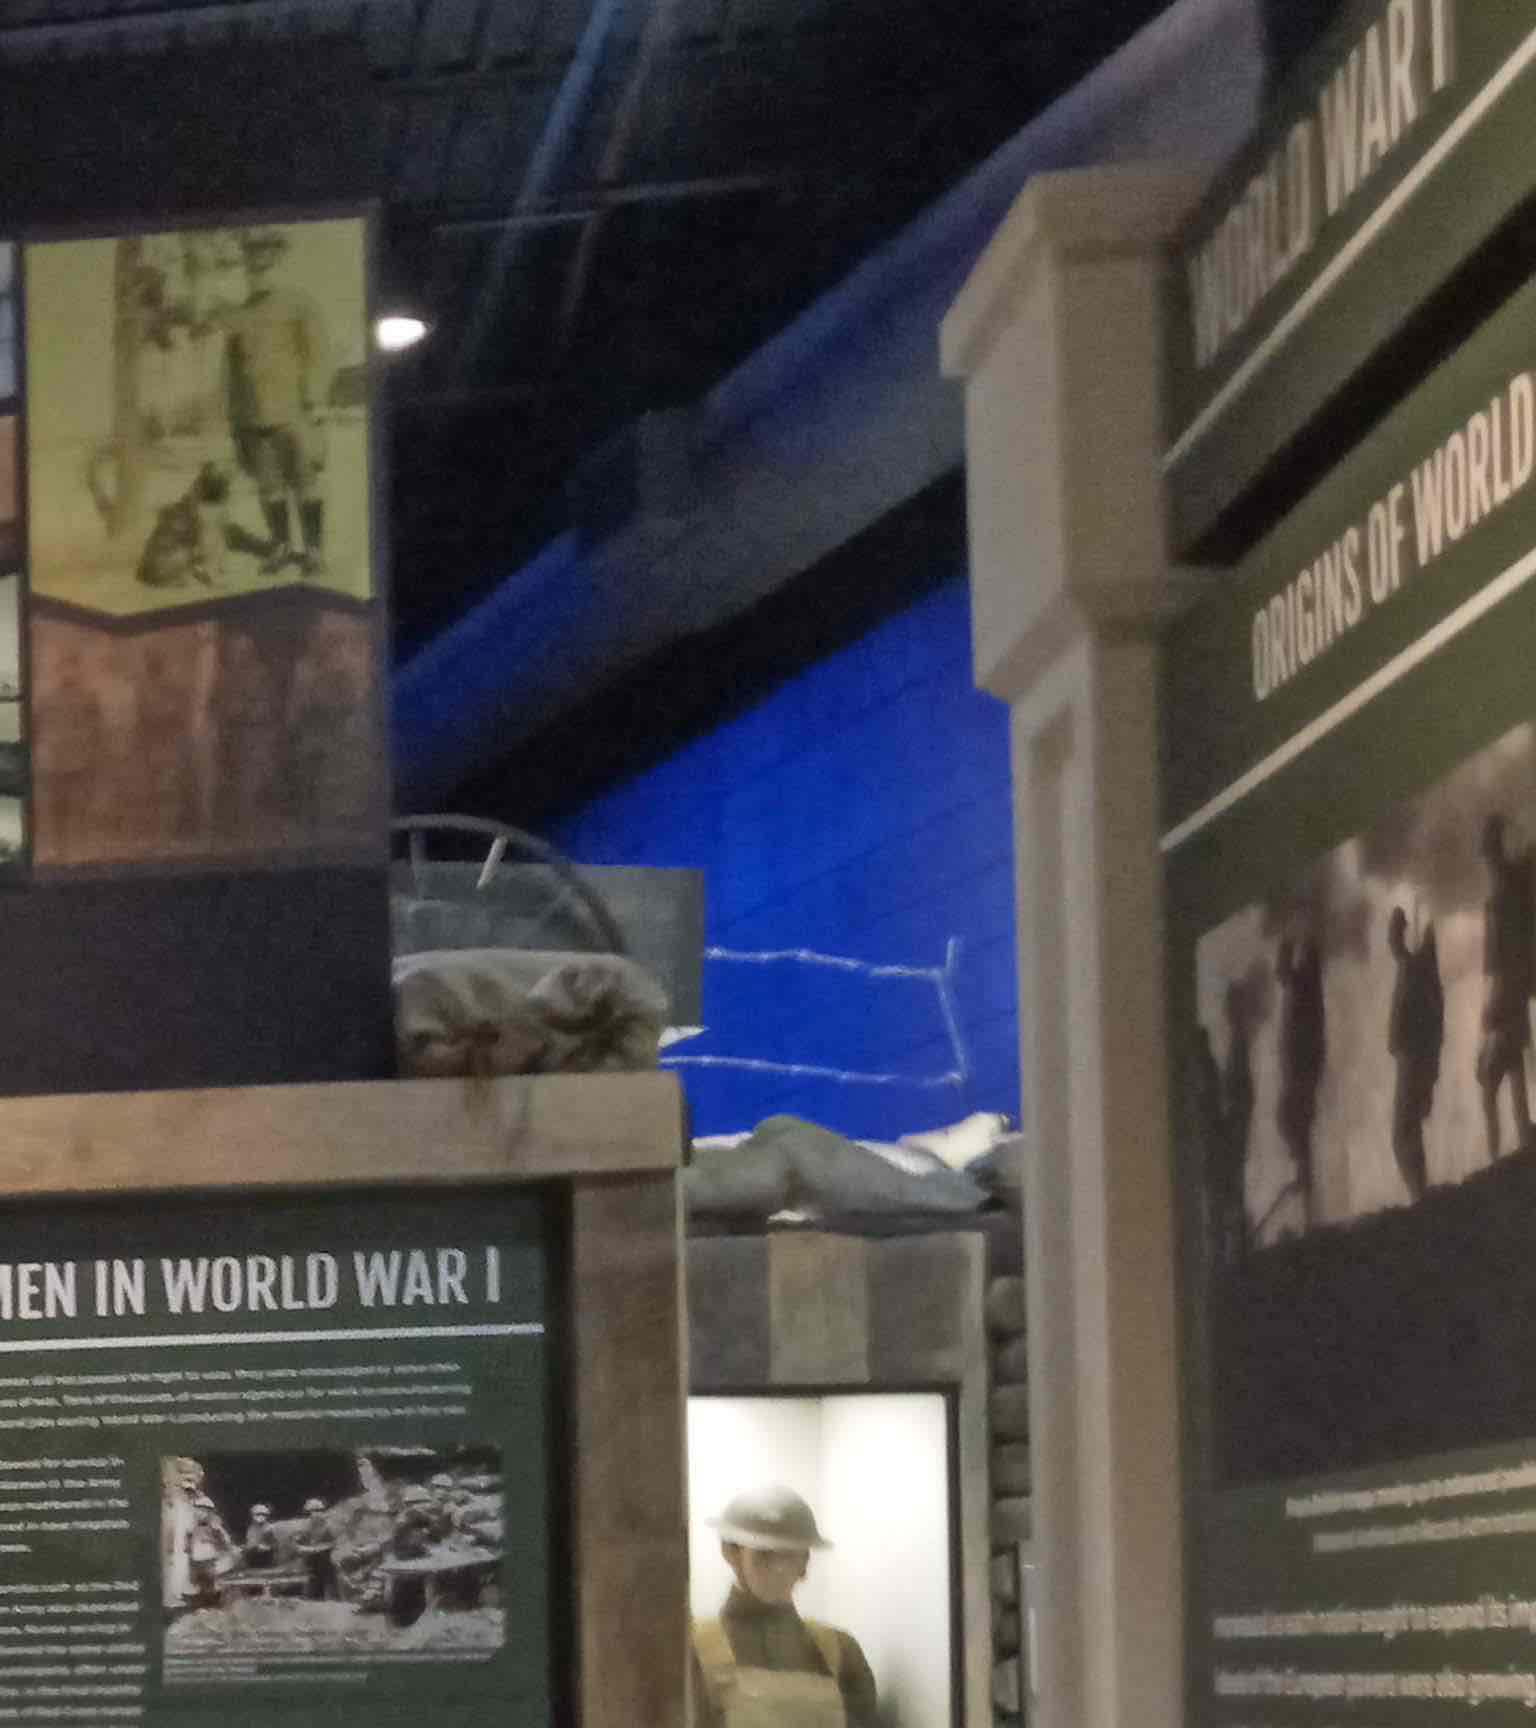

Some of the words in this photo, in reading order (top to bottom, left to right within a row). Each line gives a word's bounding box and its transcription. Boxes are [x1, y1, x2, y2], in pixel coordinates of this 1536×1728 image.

[1319, 0, 1419, 216] WAR
[1252, 527, 1363, 702] ORIGINS
[1369, 482, 1404, 604] OF
[1411, 371, 1536, 567] WORLD
[95, 1257, 146, 1317] IN
[160, 1252, 338, 1315] WORLD
[352, 1247, 469, 1308] WAR
[486, 1244, 502, 1303] I
